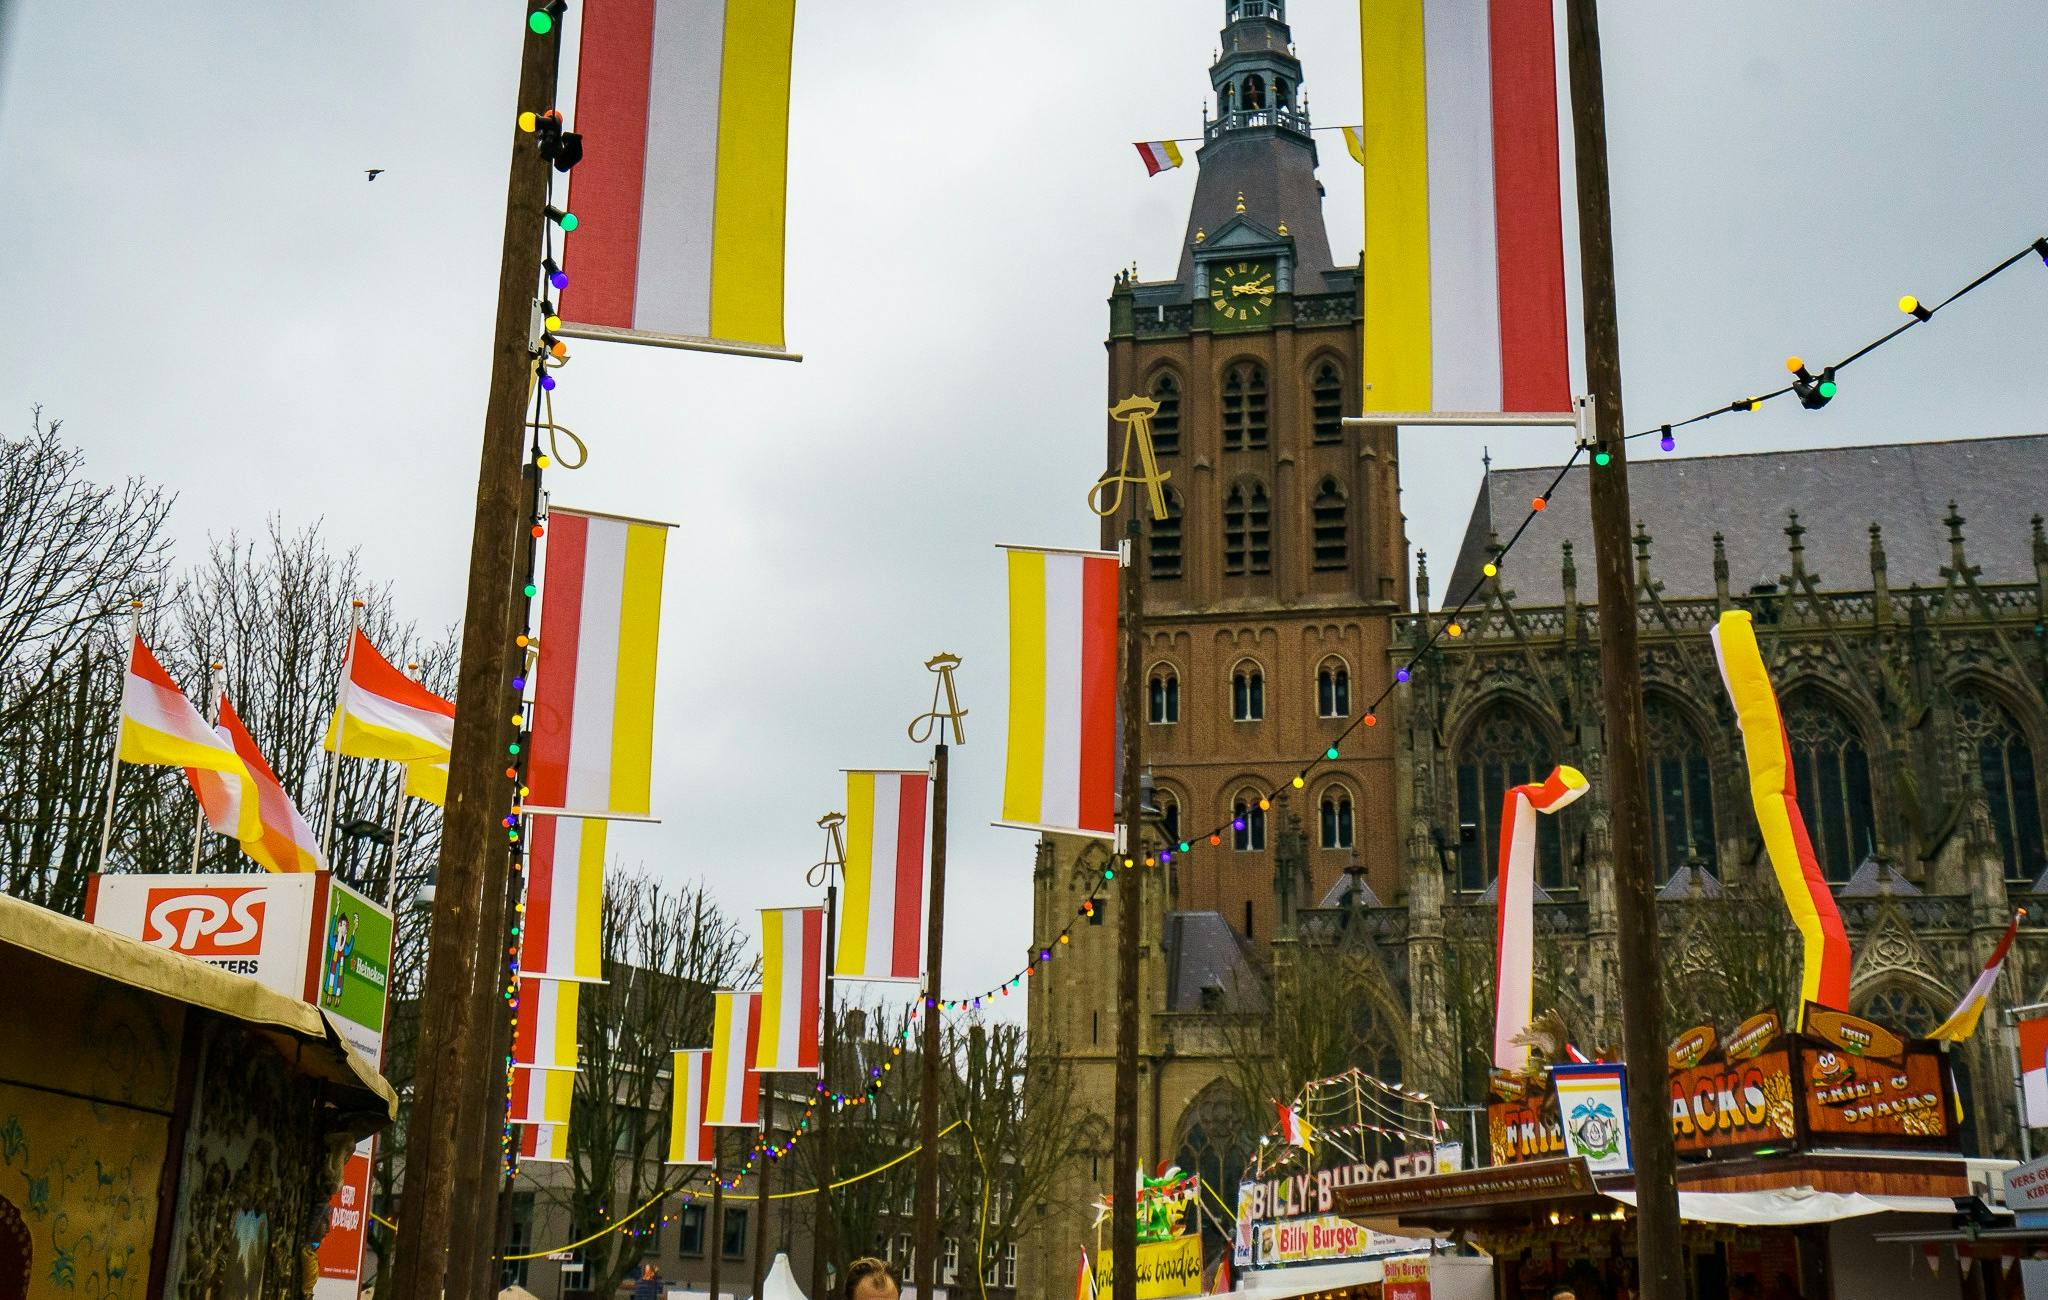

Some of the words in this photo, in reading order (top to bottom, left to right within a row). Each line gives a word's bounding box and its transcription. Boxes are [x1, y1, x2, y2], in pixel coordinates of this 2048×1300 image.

[150, 889, 268, 950] SPS
[206, 960, 258, 974] TERS
[356, 957, 385, 986] Heineken
[1672, 1068, 1766, 1135] ACKS
[1816, 1079, 1882, 1105] FRIET
[1843, 1092, 1937, 1122] SNACKS
[1505, 1110, 1565, 1157] FRIE
[2011, 1172, 2036, 1189] VERS
[1280, 1227, 1308, 1256] Billy
[1313, 1225, 1358, 1254] Burger
[1136, 1257, 1152, 1283] cks
[1155, 1246, 1200, 1287] broodjes
[1384, 1263, 1400, 1278] Billy
[1402, 1262, 1426, 1278] Burger
